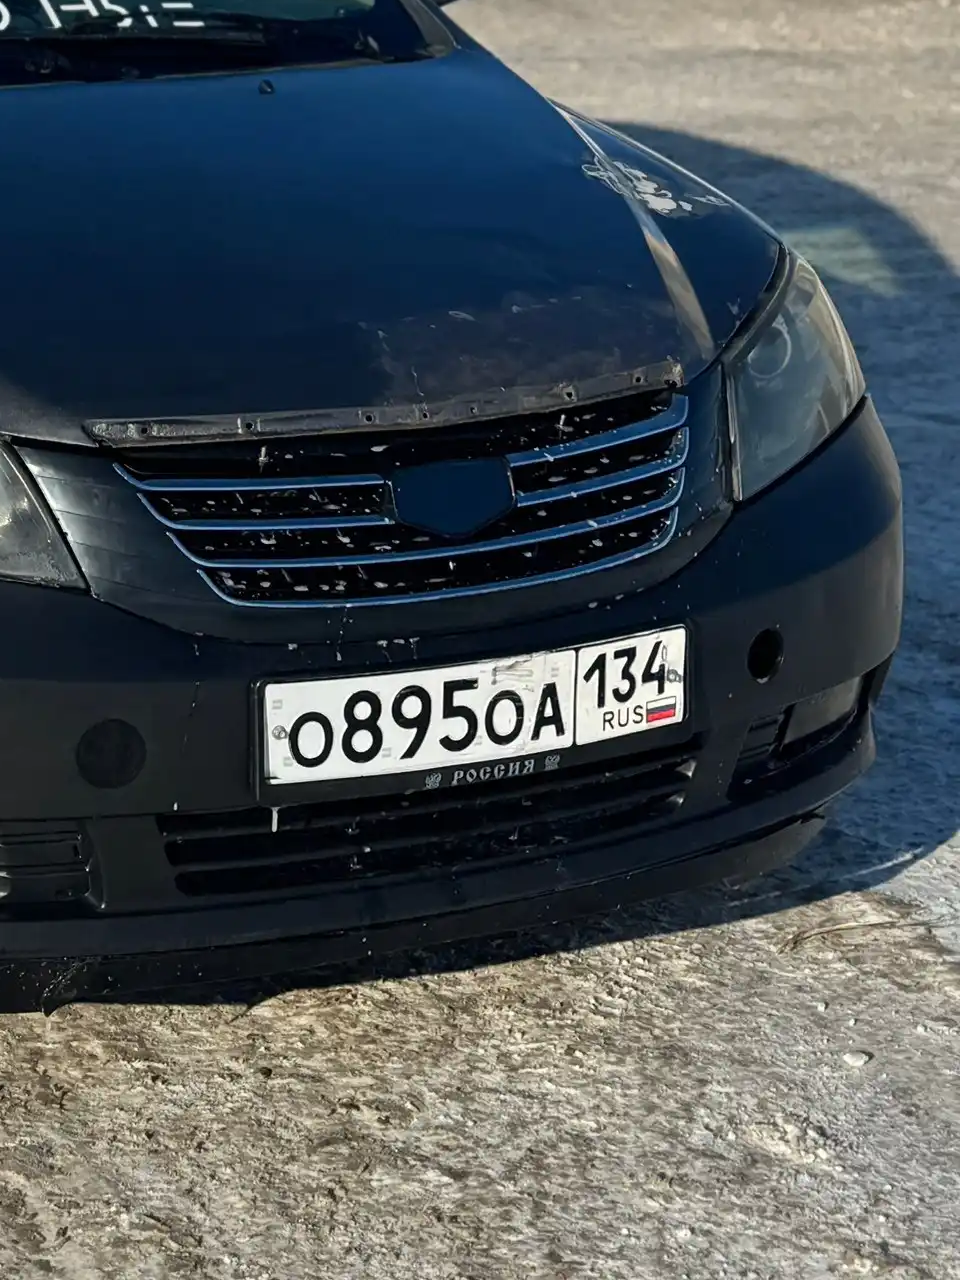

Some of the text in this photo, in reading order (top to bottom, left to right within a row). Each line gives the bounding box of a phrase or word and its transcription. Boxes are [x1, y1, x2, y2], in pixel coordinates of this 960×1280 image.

[583, 640, 664, 709] 134
[602, 704, 644, 731] RUS
[451, 758, 536, 787] РОССИЯ
